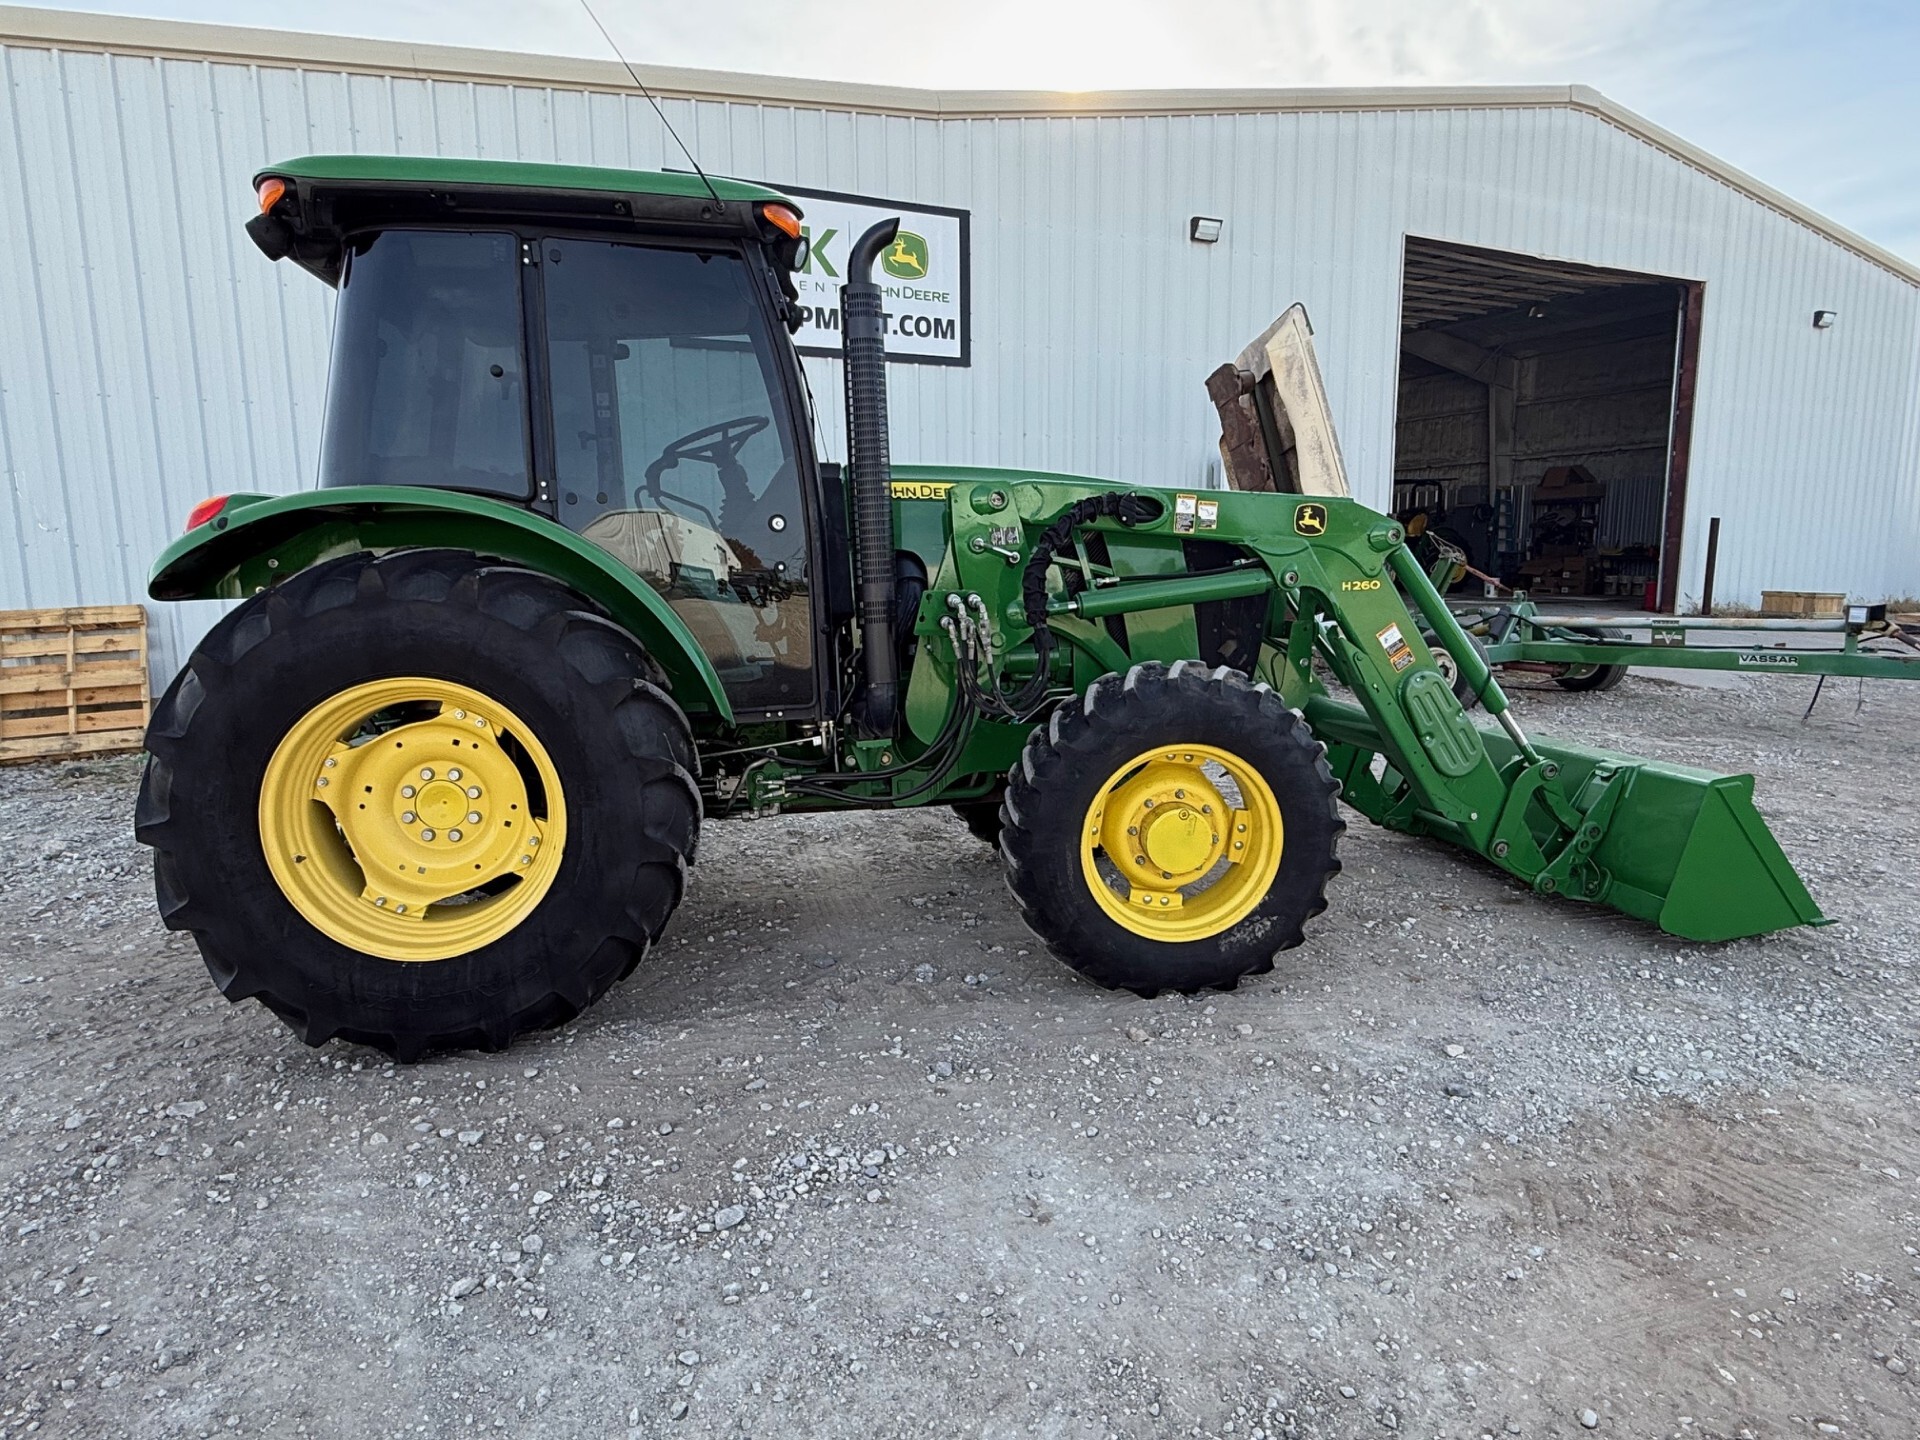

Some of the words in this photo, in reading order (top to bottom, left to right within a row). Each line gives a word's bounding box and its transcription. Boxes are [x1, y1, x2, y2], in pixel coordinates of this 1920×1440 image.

[903, 286, 950, 303] DEERE
[1342, 580, 1381, 591] H260
[1740, 654, 1798, 663] VASSAR
